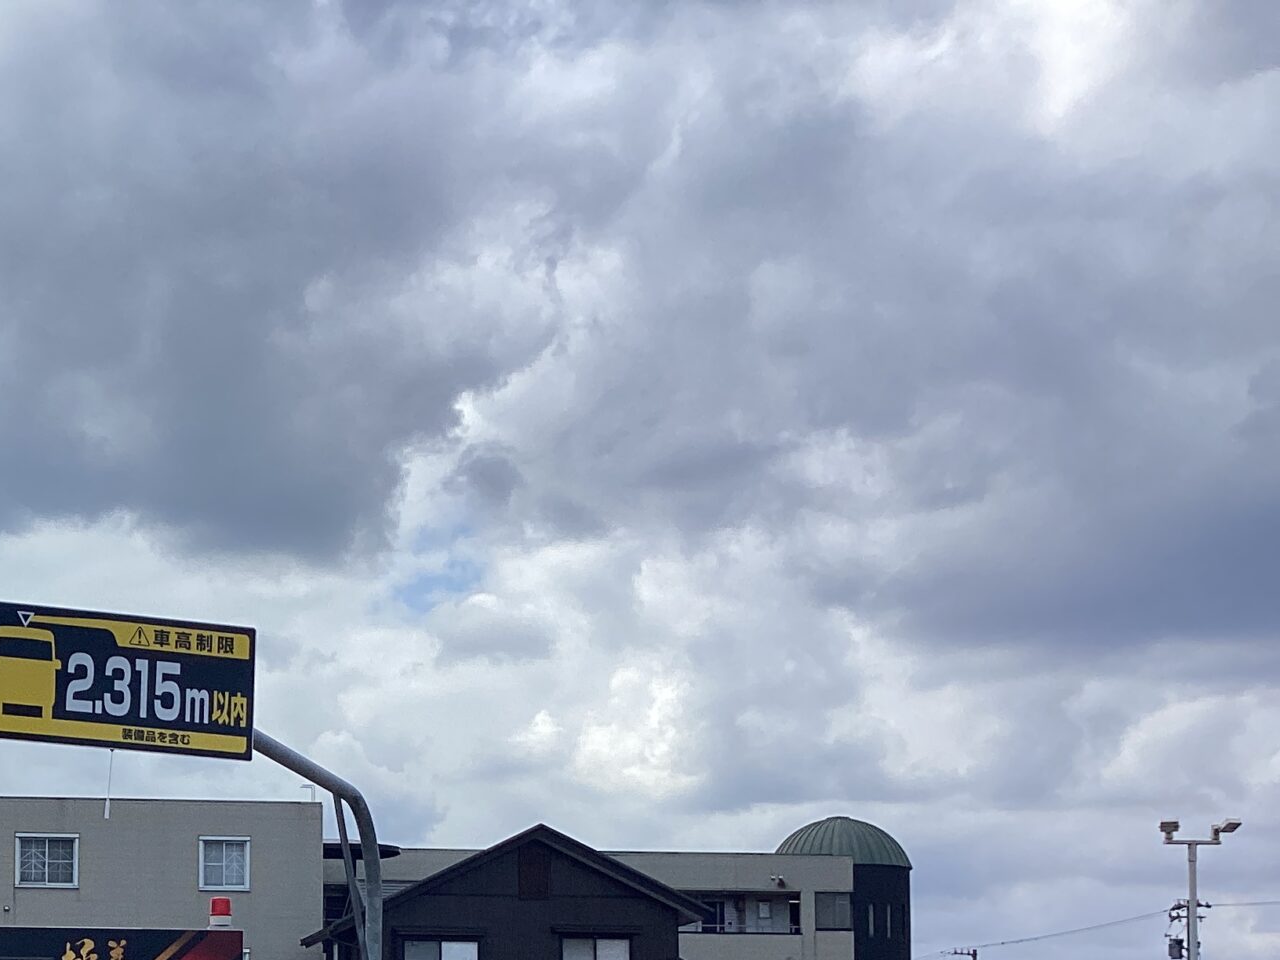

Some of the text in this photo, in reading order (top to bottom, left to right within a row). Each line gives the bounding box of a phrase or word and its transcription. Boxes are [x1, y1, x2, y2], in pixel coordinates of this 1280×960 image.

[153, 629, 234, 654] 車高制限
[122, 728, 191, 745] 装備品を含む
